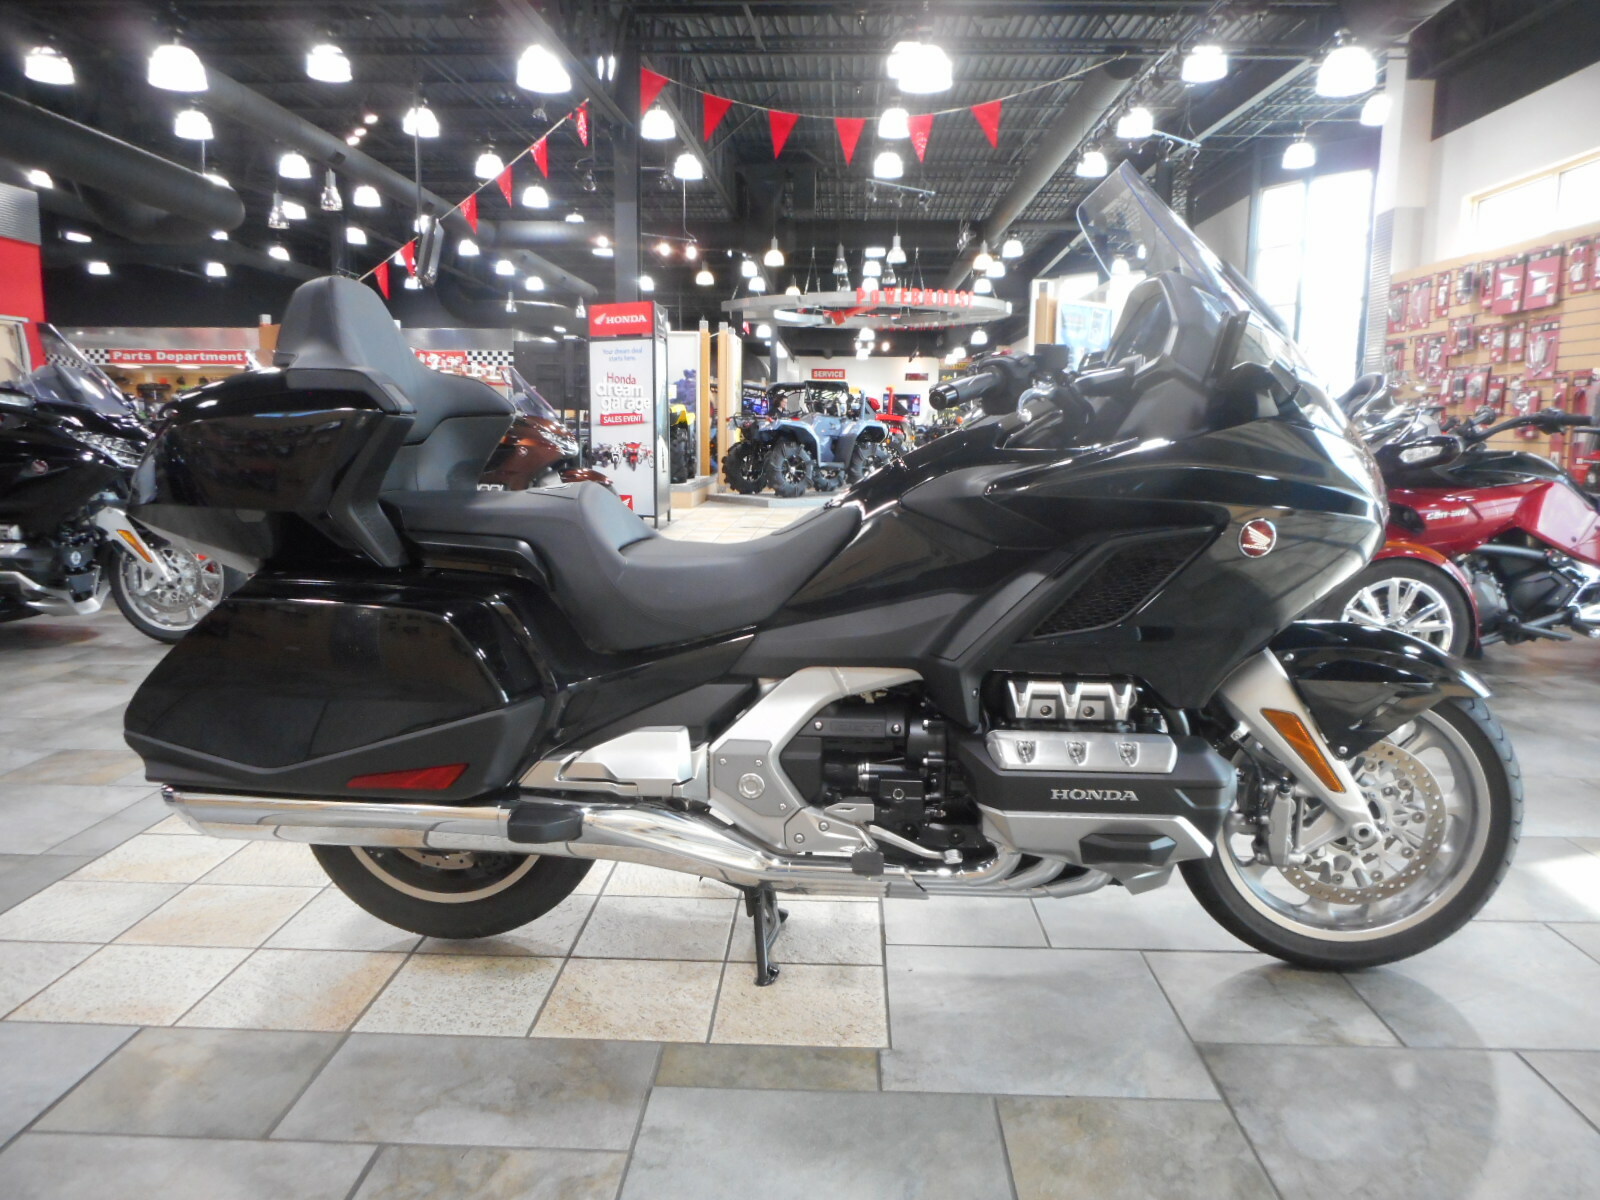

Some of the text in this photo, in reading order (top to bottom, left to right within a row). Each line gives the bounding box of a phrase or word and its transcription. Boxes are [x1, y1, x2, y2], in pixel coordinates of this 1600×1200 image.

[605, 314, 647, 324] HONDA
[112, 351, 243, 362] Parts Department
[606, 371, 637, 385] Honda
[813, 370, 844, 378] SERVICE
[595, 378, 643, 397] dream
[600, 397, 650, 414] garage
[603, 415, 642, 424] SALES EVENT
[1050, 788, 1139, 801] HONDA
